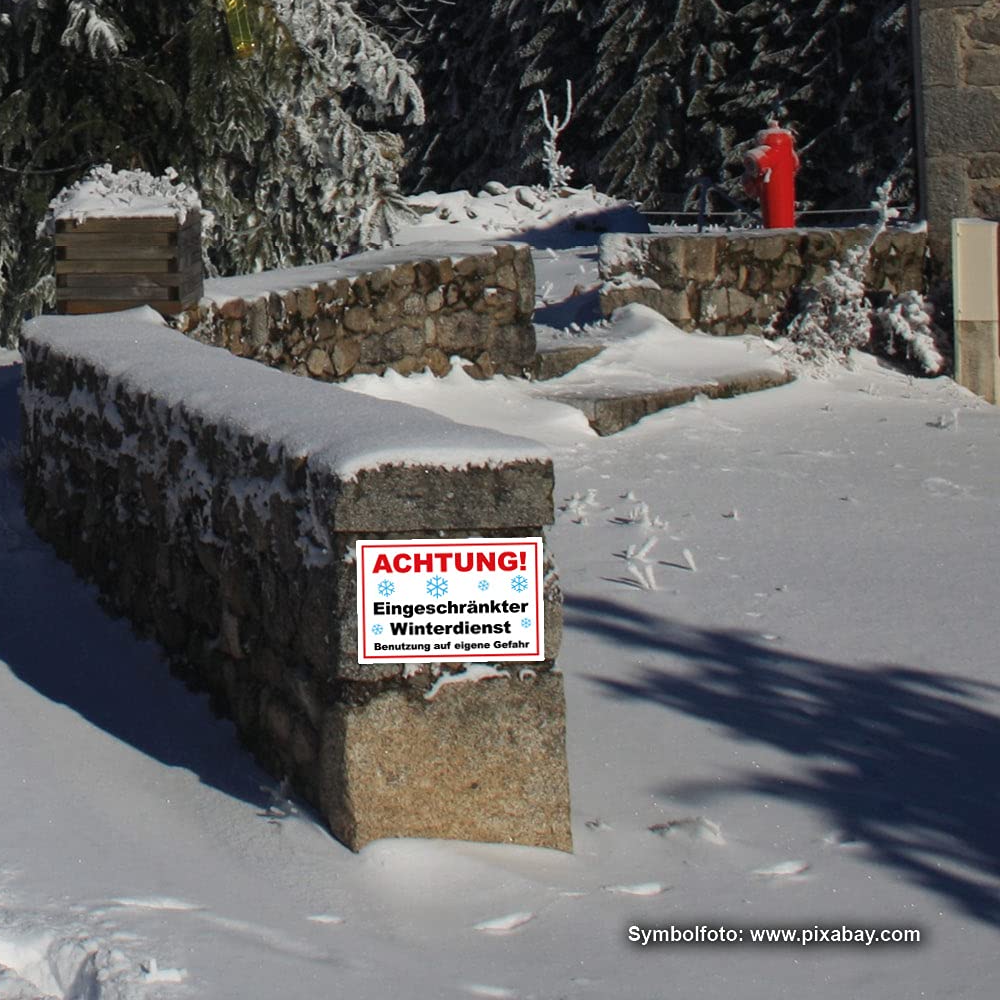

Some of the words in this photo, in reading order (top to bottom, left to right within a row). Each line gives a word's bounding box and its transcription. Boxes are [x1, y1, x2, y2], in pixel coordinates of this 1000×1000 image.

[372, 551, 527, 573] ACHTUNG!
[373, 600, 529, 618] Eingeschränkter
[390, 620, 511, 635] Winterdienst
[374, 642, 430, 651] Benutzung
[433, 641, 451, 650] auf
[454, 641, 490, 651] eigene
[493, 640, 530, 649] Gefahr
